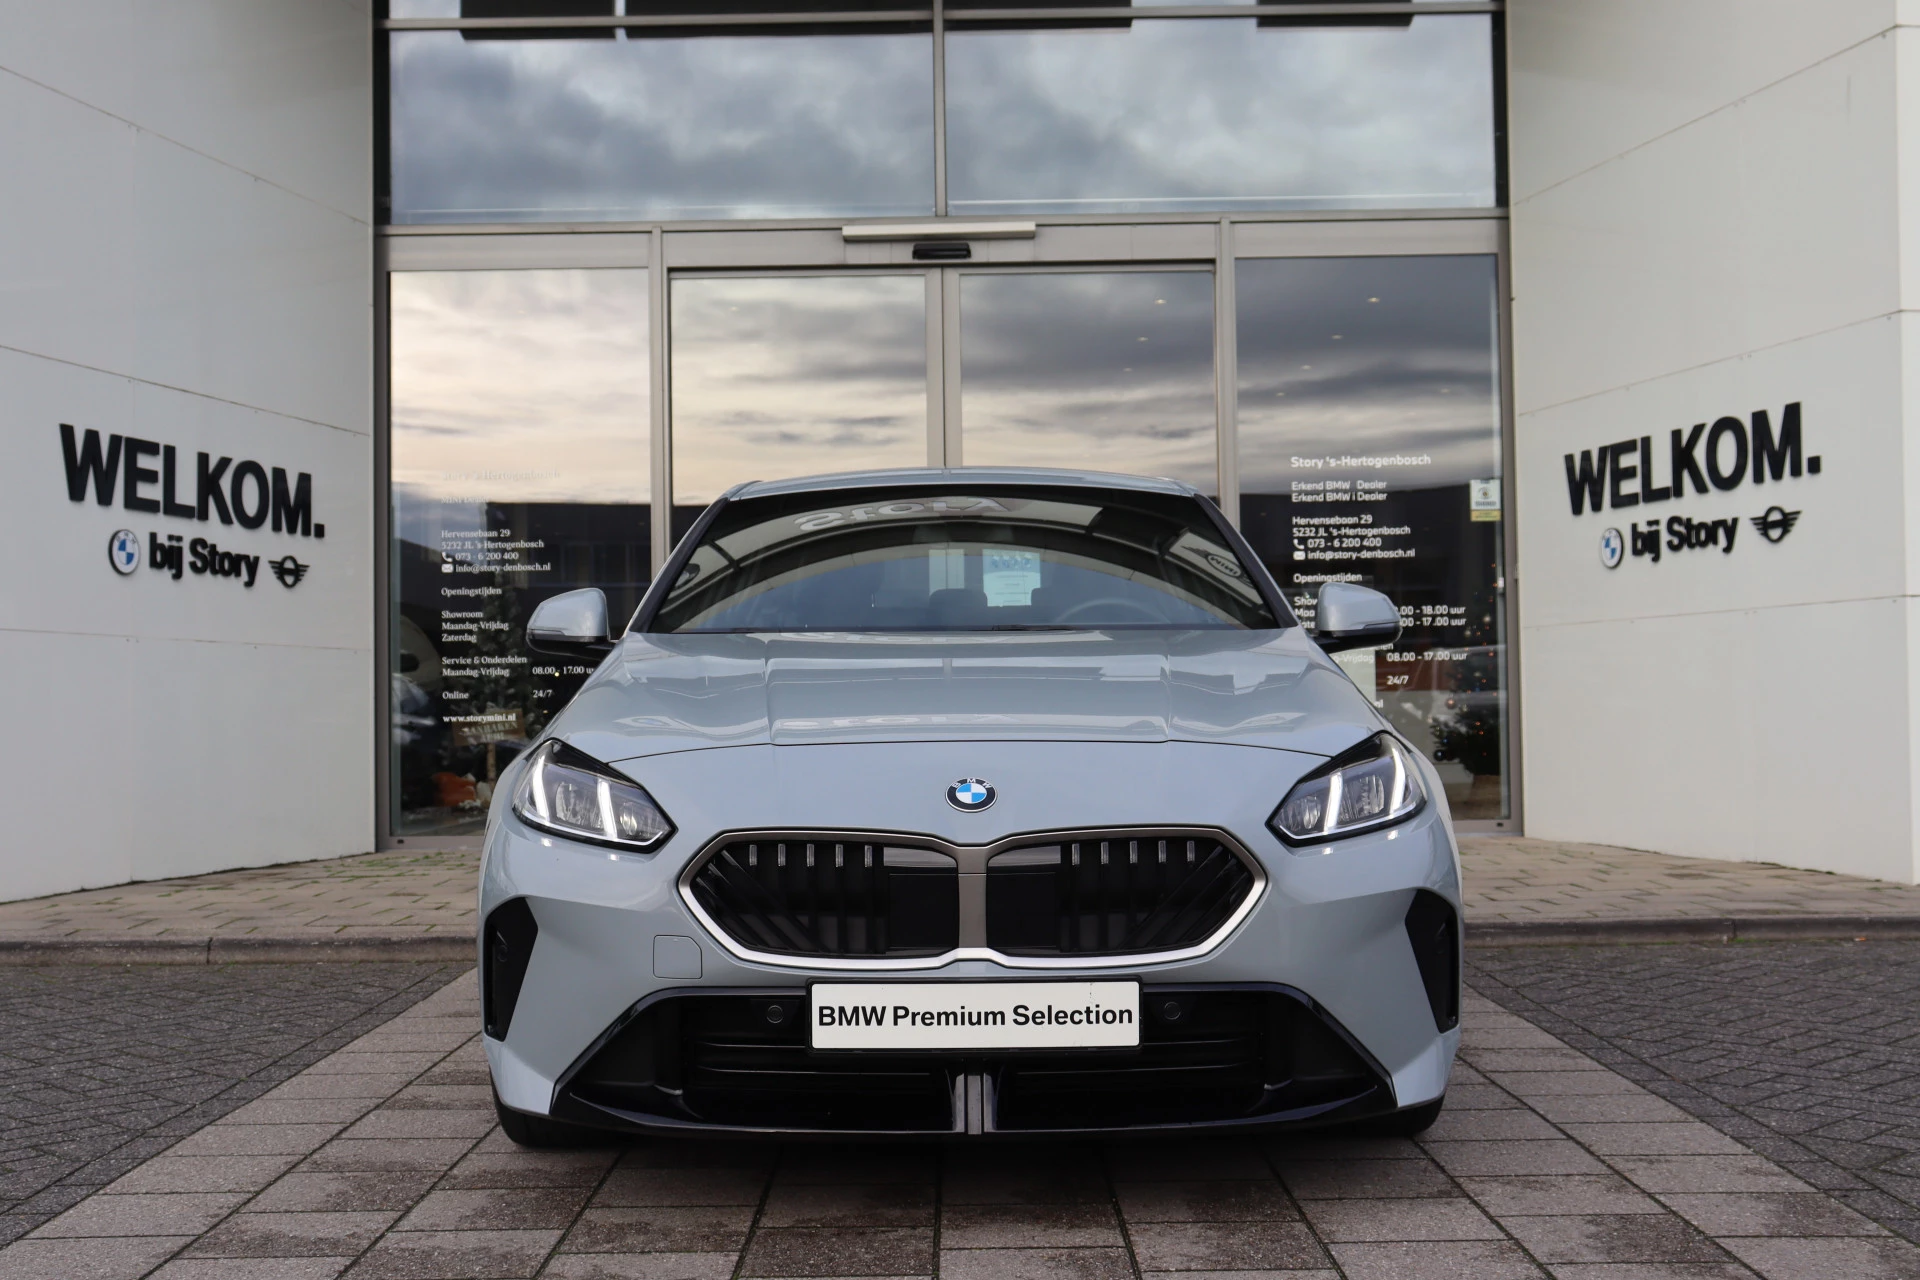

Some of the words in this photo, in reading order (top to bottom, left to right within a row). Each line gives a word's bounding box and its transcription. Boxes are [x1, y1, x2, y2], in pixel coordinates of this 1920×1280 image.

[1290, 456, 1323, 469] Story
[1564, 401, 1822, 516] WELKOM.
[59, 423, 325, 539] WELKOM.
[1291, 481, 1324, 491] Erkend
[1326, 481, 1351, 490] BMW
[1357, 480, 1387, 489] Dealer
[1291, 493, 1324, 502] Erkend
[1326, 492, 1351, 502] BMW
[1357, 491, 1387, 501] Dealer
[1292, 515, 1358, 525] Hervensebaan
[1360, 514, 1373, 524] 29
[441, 529, 498, 539] Hervensebaan
[500, 528, 511, 538] 29
[1292, 527, 1315, 537] 5232
[1318, 527, 1327, 537] JL
[1307, 539, 1325, 548] 073
[1333, 538, 1340, 548] 6
[1342, 538, 1361, 548] 200
[1363, 537, 1382, 547] 400
[1631, 519, 1661, 563] bij
[1666, 515, 1739, 554] Story
[441, 541, 462, 550] 5232
[464, 541, 474, 550] JL
[149, 531, 183, 580] bij
[189, 537, 260, 588] Story
[455, 552, 471, 561] 073
[477, 552, 483, 561] 6
[485, 552, 501, 561] 200
[503, 551, 519, 560] 400
[1307, 548, 1416, 561] info@story-denbosch.nl
[455, 562, 552, 574] info@story-denbosch.nl
[1293, 573, 1362, 584] Openingstijden
[441, 586, 502, 597] Openingstijden
[441, 610, 483, 619] Showroom
[1421, 605, 1448, 615] 18.00
[1449, 606, 1466, 615] uur
[441, 621, 509, 631] Maandag-Vrijdag
[1450, 618, 1467, 626] uur
[441, 633, 477, 643] Zaterdag
[442, 656, 472, 665] Service
[474, 656, 480, 665] &
[481, 655, 527, 665] Onderdelen
[1386, 652, 1416, 662] 08.00
[1451, 653, 1468, 661] uur
[442, 667, 509, 677] Maandag-Vrijdag
[532, 666, 555, 675] 08.00
[563, 665, 585, 675] 17.00
[1386, 675, 1409, 685] 24/7
[442, 690, 469, 699] Online
[532, 689, 553, 698] 24/7
[443, 713, 516, 723] www.storymini.nl
[951, 777, 992, 789] BMW
[818, 1005, 887, 1027] BMW
[893, 1005, 1006, 1027] Premium
[1012, 1003, 1134, 1026] Selection
